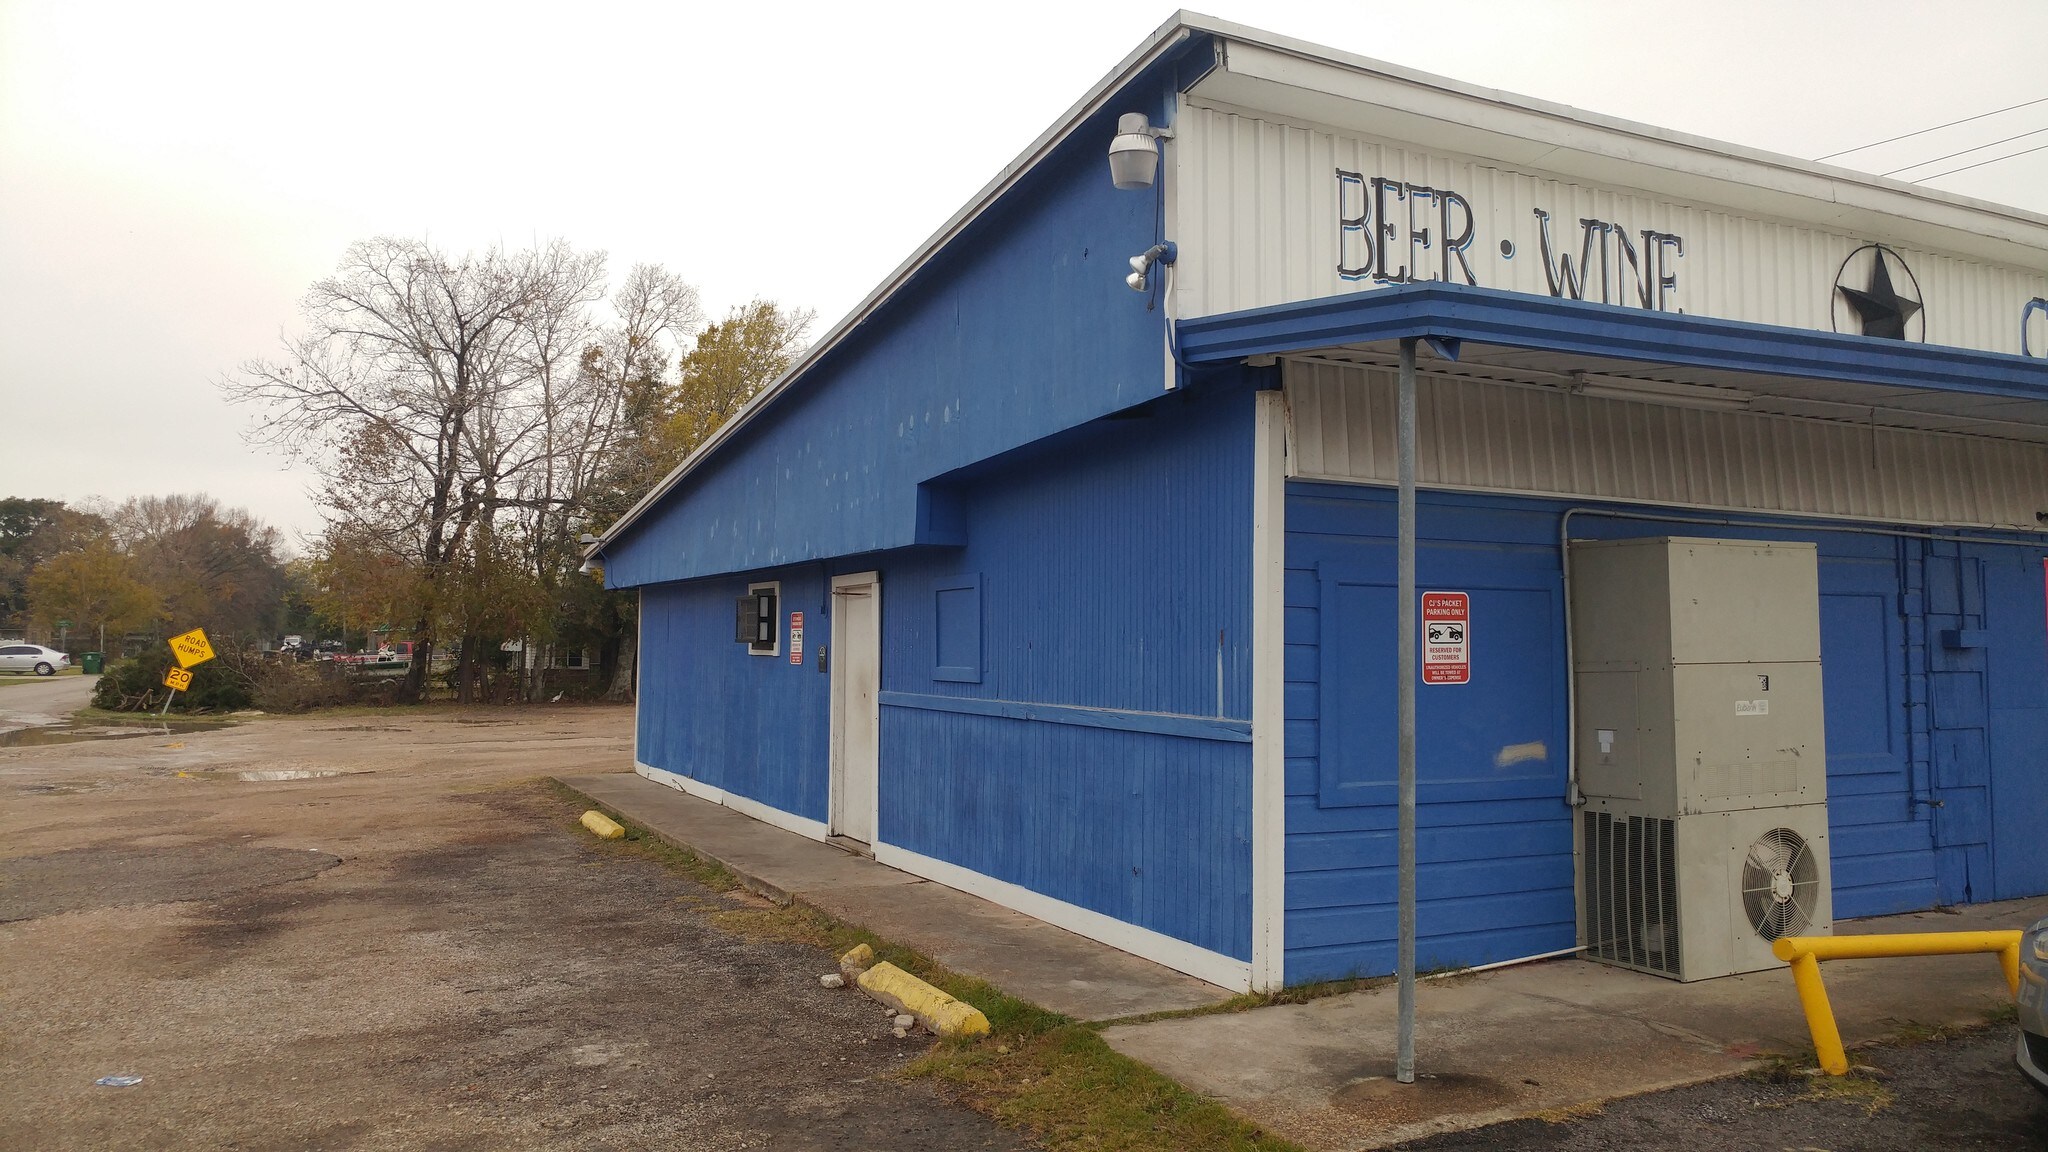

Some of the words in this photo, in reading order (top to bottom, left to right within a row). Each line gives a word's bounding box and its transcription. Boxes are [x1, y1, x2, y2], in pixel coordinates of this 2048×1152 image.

[1336, 168, 1478, 286] BEER
[1534, 208, 1684, 314] WINE
[1426, 608, 1450, 616] PARKING
[1450, 608, 1465, 616] ONLY
[184, 635, 206, 648] ROAD
[177, 643, 206, 658] HUMPS
[170, 669, 190, 683] 20
